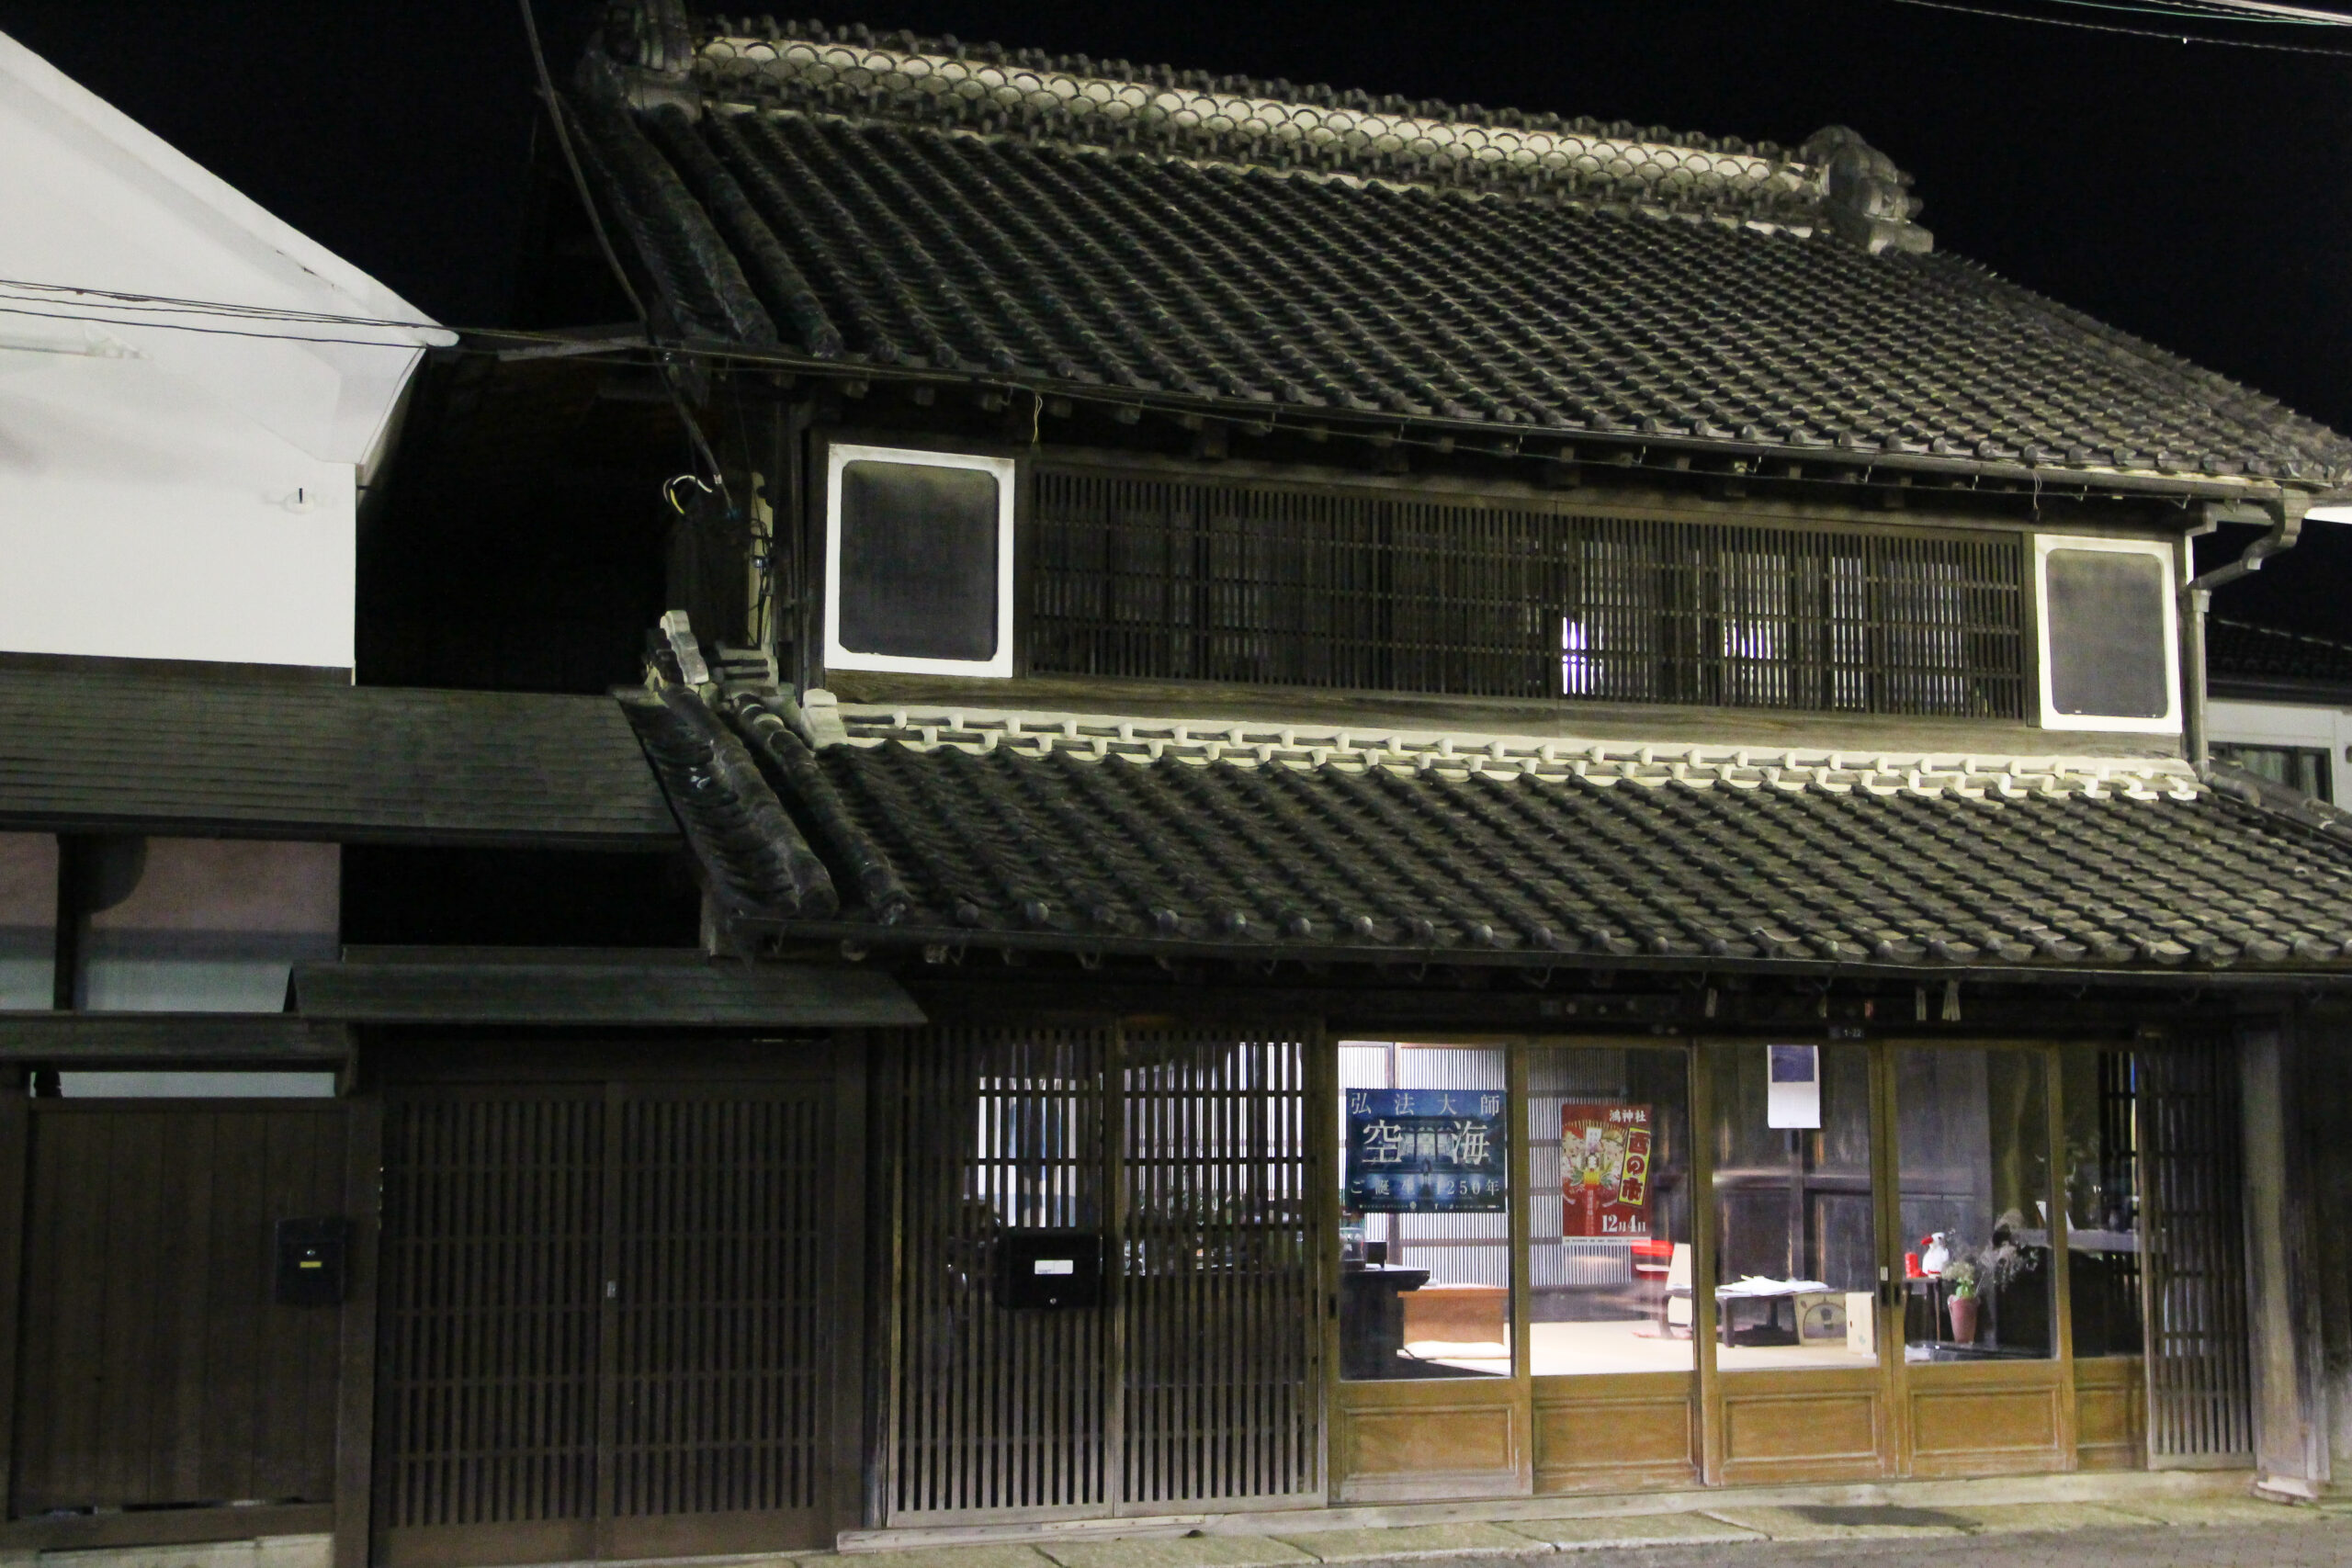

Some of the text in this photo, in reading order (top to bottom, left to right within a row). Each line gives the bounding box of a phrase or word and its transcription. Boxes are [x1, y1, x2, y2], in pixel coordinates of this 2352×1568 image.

[1351, 1092, 1500, 1117] 弘法大師
[1609, 1109, 1647, 1122] 鴻神社
[1362, 1119, 1490, 1166] 空海
[1622, 1130, 1651, 1201] 酉の市
[1351, 1179, 1499, 1196] ご誕生1250年
[1601, 1213, 1646, 1233] 12月4日
